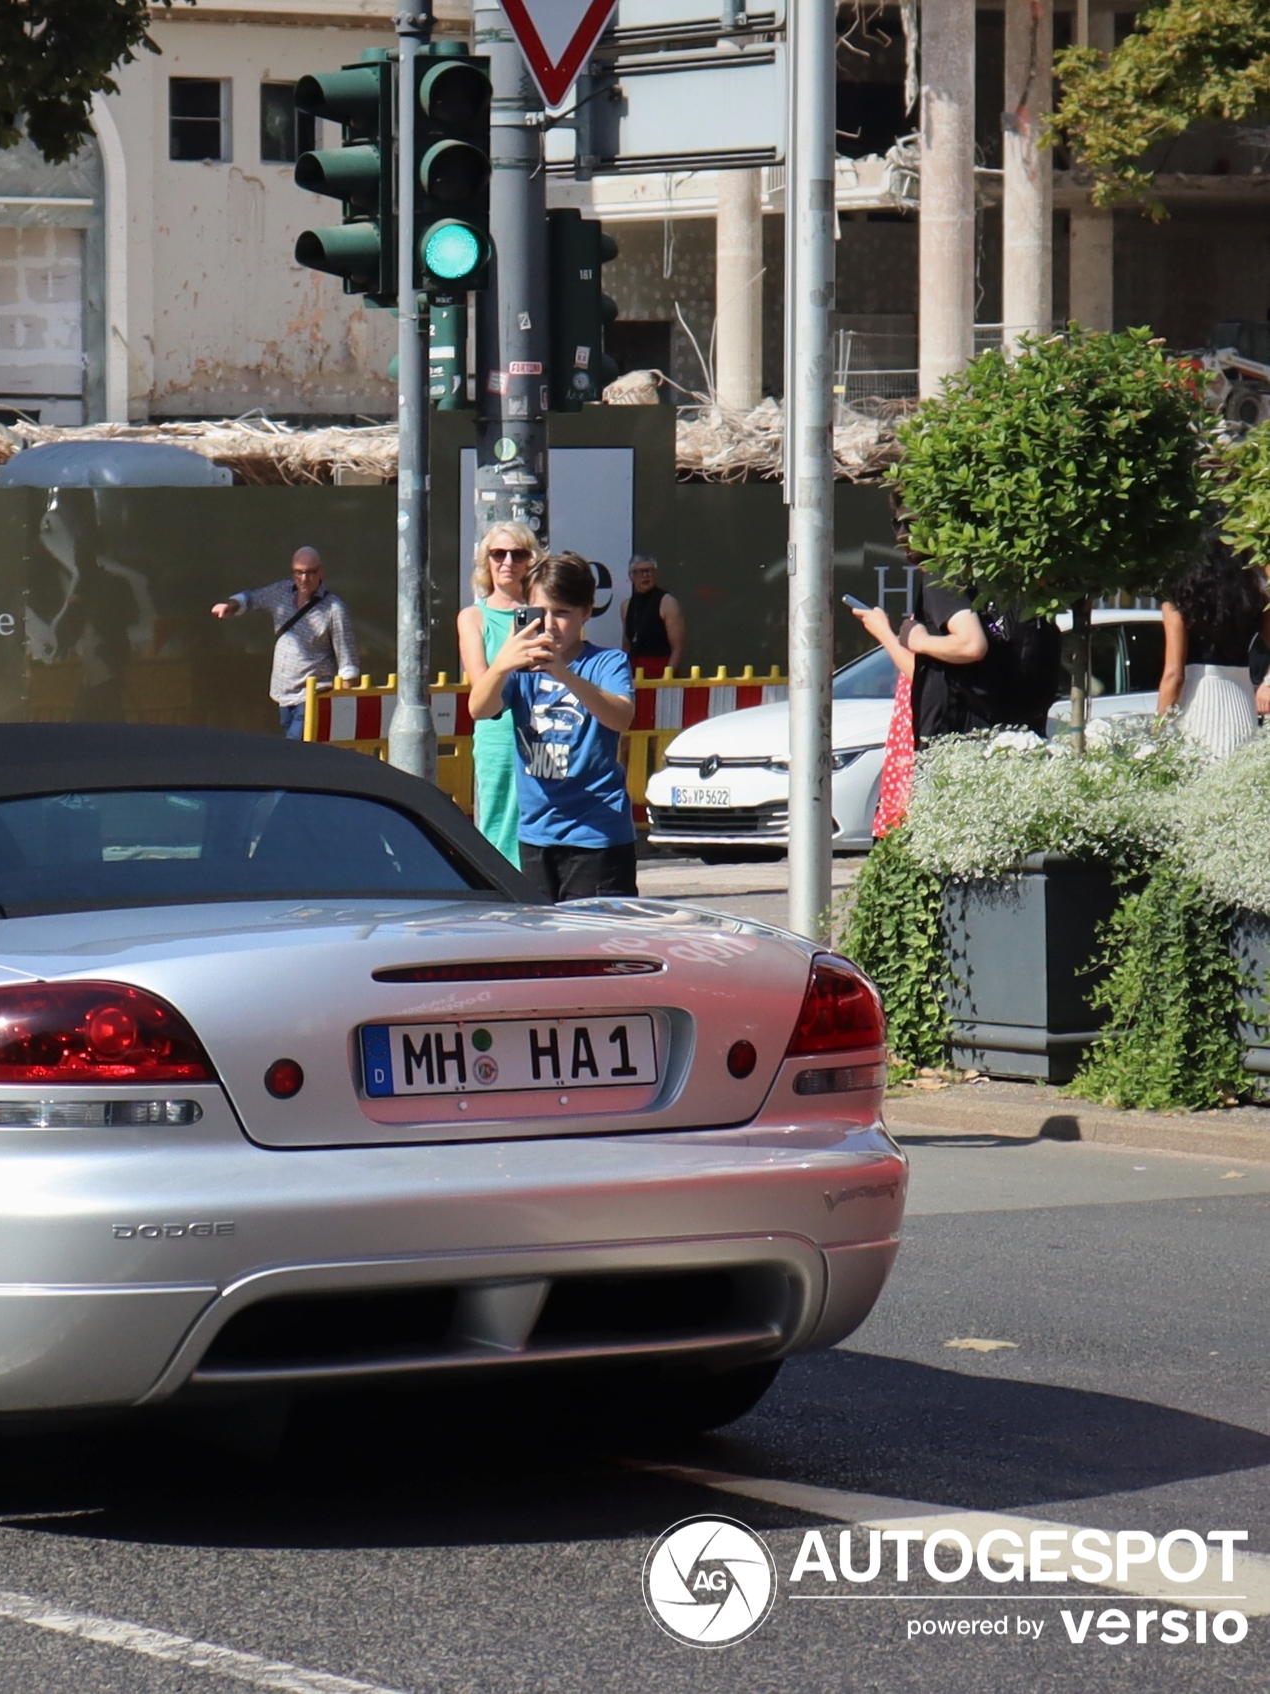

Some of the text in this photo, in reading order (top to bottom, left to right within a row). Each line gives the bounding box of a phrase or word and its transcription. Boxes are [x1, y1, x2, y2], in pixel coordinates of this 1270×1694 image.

[676, 789, 729, 806] BS XP 5622
[402, 1031, 467, 1086] MH
[374, 1068, 385, 1084] D
[112, 1221, 235, 1239] DODGE
